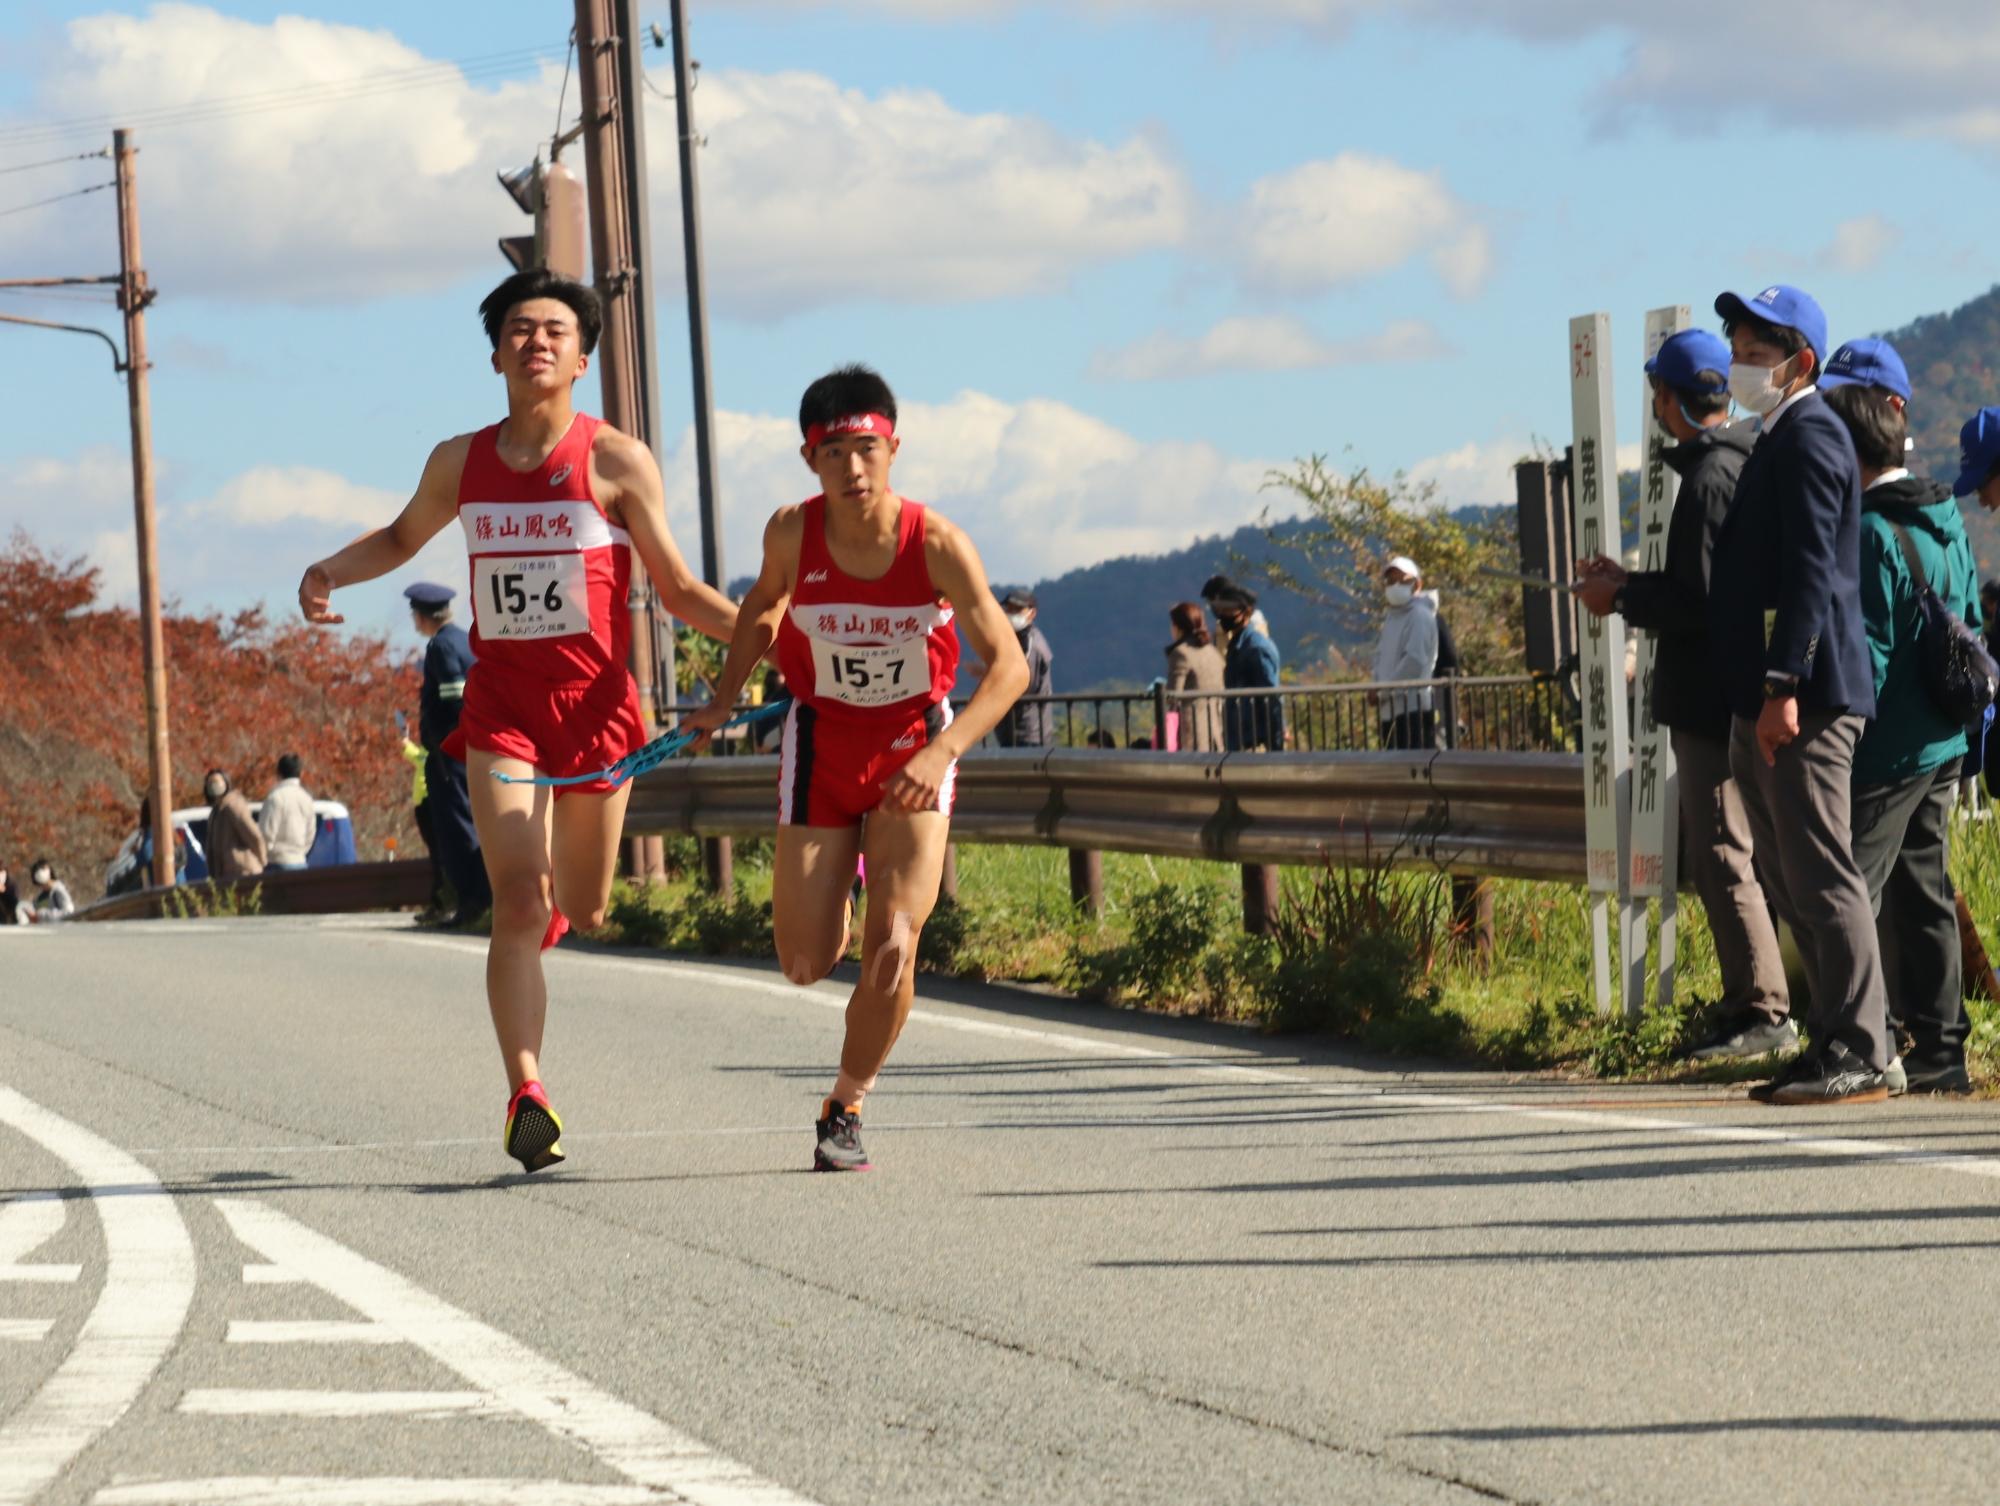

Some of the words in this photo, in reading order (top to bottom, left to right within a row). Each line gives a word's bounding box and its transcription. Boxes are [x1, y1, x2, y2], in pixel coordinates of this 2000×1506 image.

[475, 513, 573, 540] 篠山鳳鳴
[491, 573, 563, 615] 15-6
[817, 613, 920, 638] 篠山鳳鳴
[832, 653, 905, 688] 15-7
